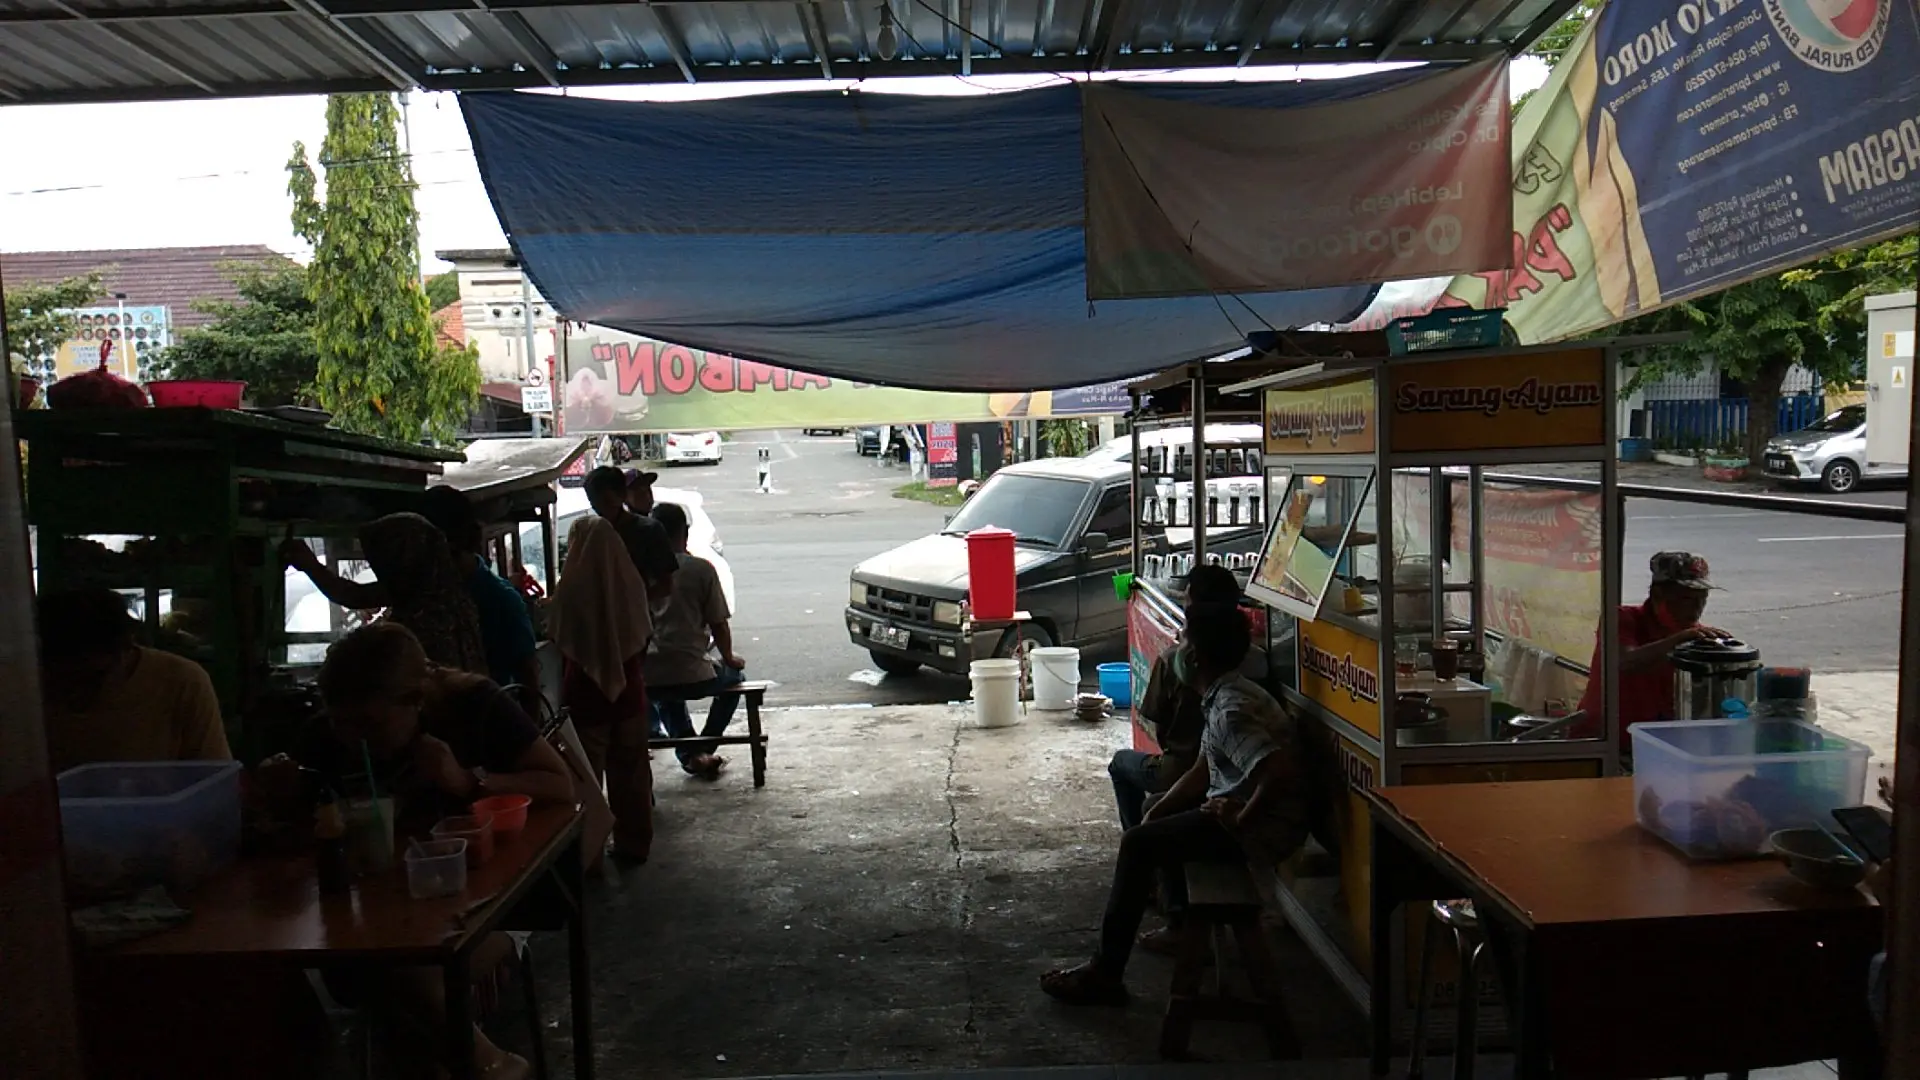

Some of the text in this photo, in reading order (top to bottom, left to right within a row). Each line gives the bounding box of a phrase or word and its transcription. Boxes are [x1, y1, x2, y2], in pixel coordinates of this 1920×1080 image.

[1270, 389, 1367, 447] Sarang Ayam
[1396, 376, 1603, 415] Sarang Ayam
[1302, 634, 1380, 704] Sarang Ayam
